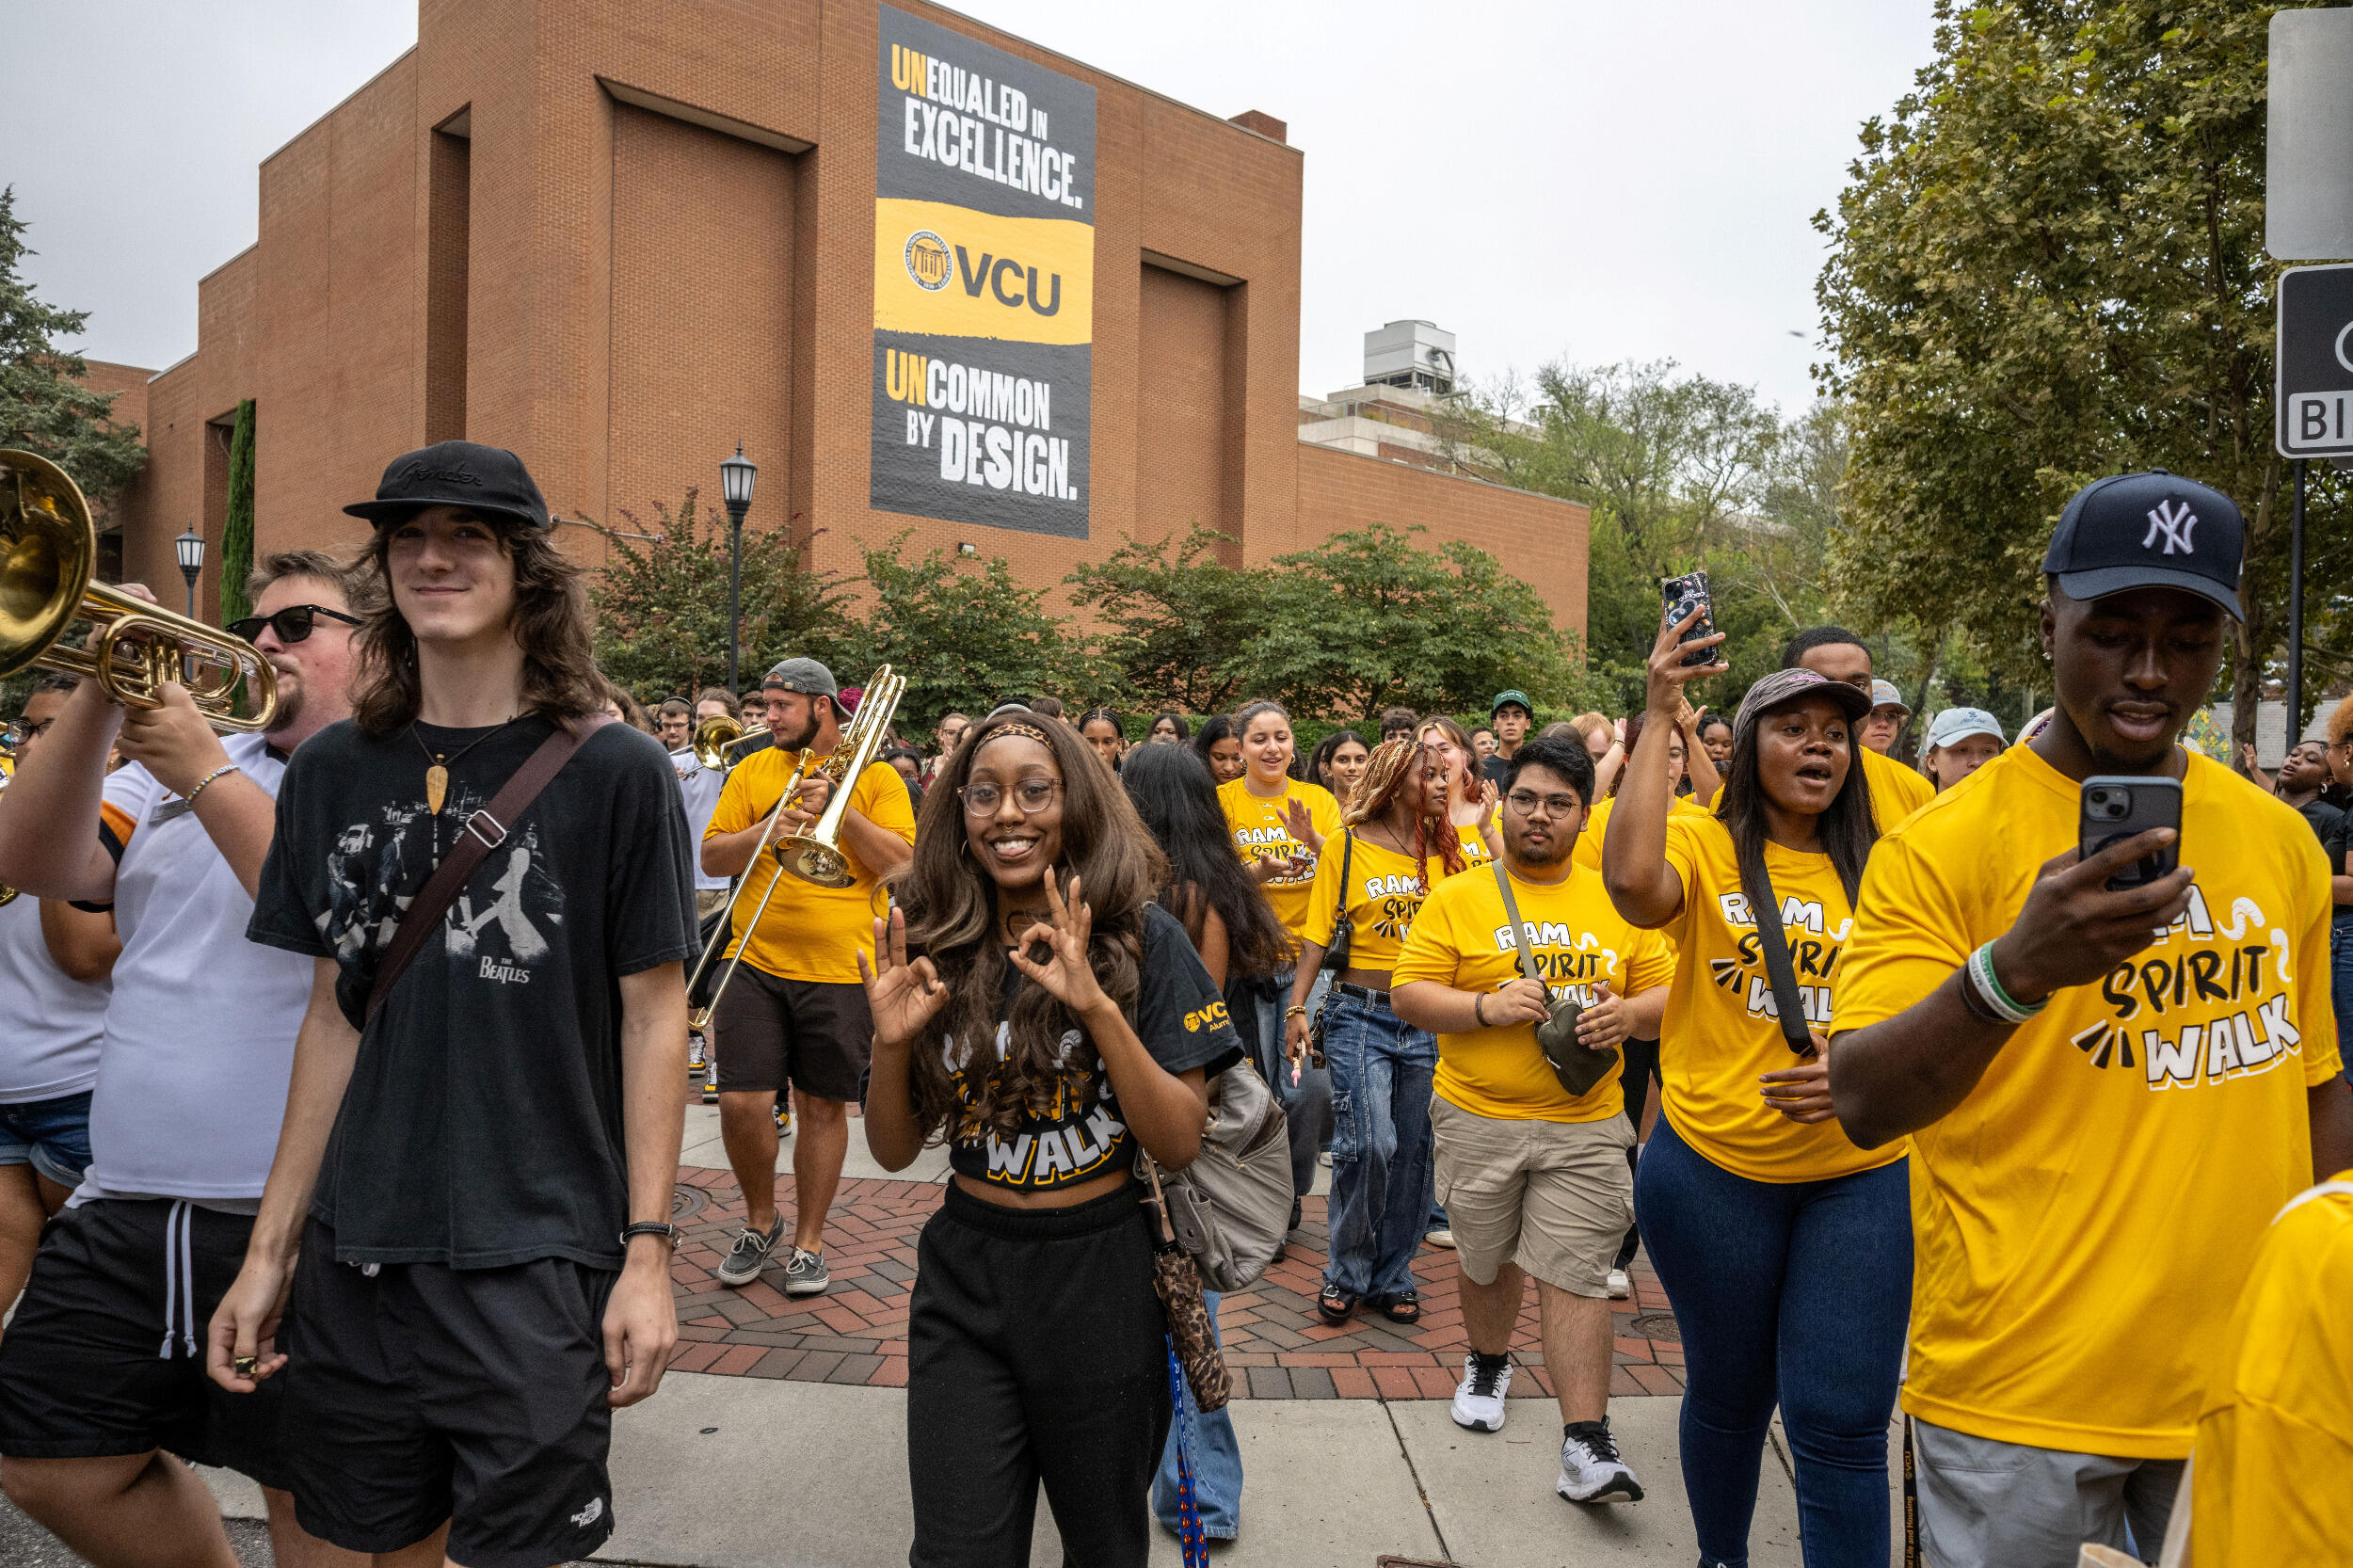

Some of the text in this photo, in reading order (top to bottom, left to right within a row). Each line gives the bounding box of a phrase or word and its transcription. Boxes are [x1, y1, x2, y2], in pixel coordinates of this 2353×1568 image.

[891, 43, 1048, 141] UNEQUALED IN
[904, 96, 1082, 209] EXCELLENCE.
[954, 245, 1061, 316] VCU
[886, 348, 1049, 430] UNCOMMON
[2301, 398, 2344, 440] BI
[396, 459, 483, 490] Fender
[906, 409, 1078, 501] BY DESIGN.
[2141, 499, 2199, 555] NY
[1234, 825, 1289, 847] RAM
[1365, 874, 1425, 902] RAM
[1719, 891, 1823, 936] RM
[479, 955, 531, 984] BEATLES
[2102, 945, 2269, 1021] SPIRIT
[1197, 1001, 1229, 1023] VC
[1747, 975, 1833, 1029] WAL
[1209, 1019, 1230, 1033] Alum
[2141, 992, 2302, 1091] WALK
[987, 1104, 1128, 1185] WALK
[1904, 1450, 1913, 1472] VCU
[1905, 1496, 1914, 1528] Housing
[1906, 1529, 1914, 1544] and
